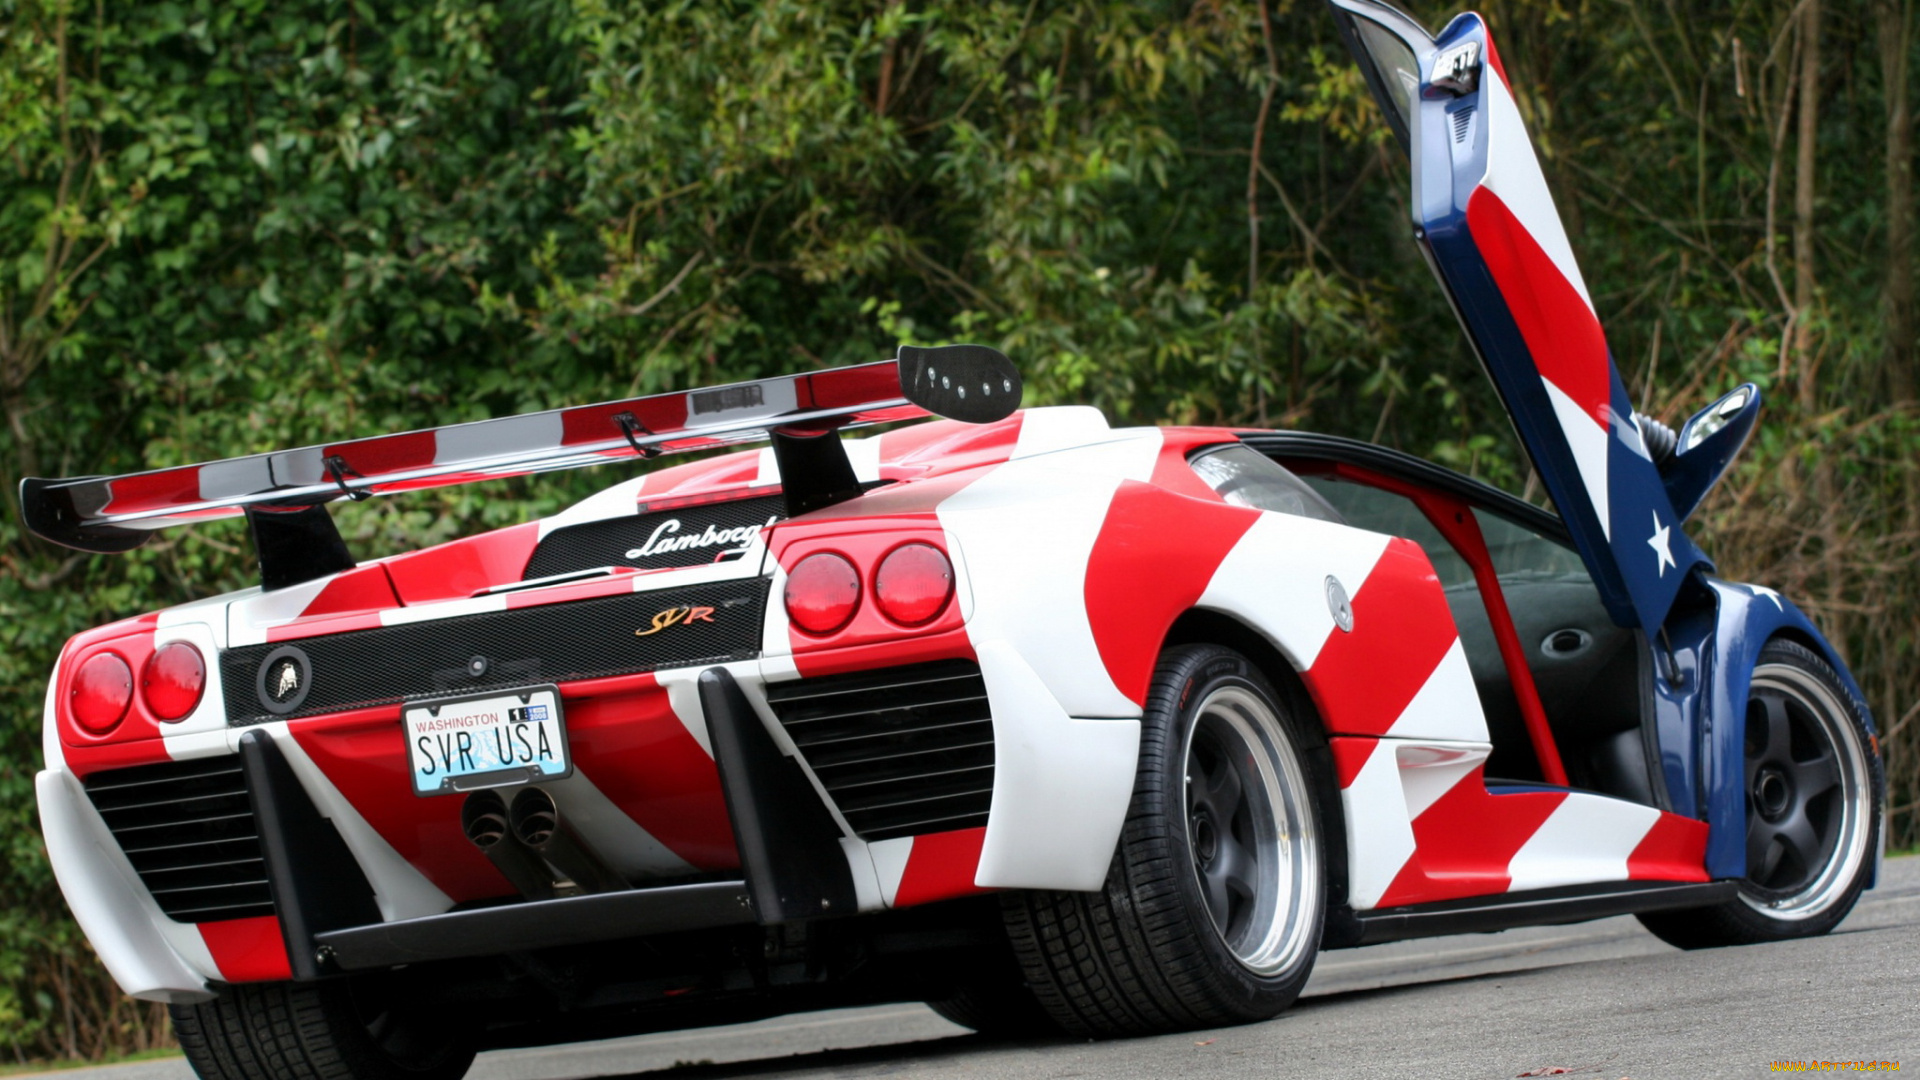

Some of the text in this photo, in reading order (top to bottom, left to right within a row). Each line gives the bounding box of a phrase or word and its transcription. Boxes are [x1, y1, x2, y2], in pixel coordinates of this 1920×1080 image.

[635, 605, 715, 636] SVR
[415, 712, 499, 733] WASHINGTON
[417, 721, 553, 775] SVR USA
